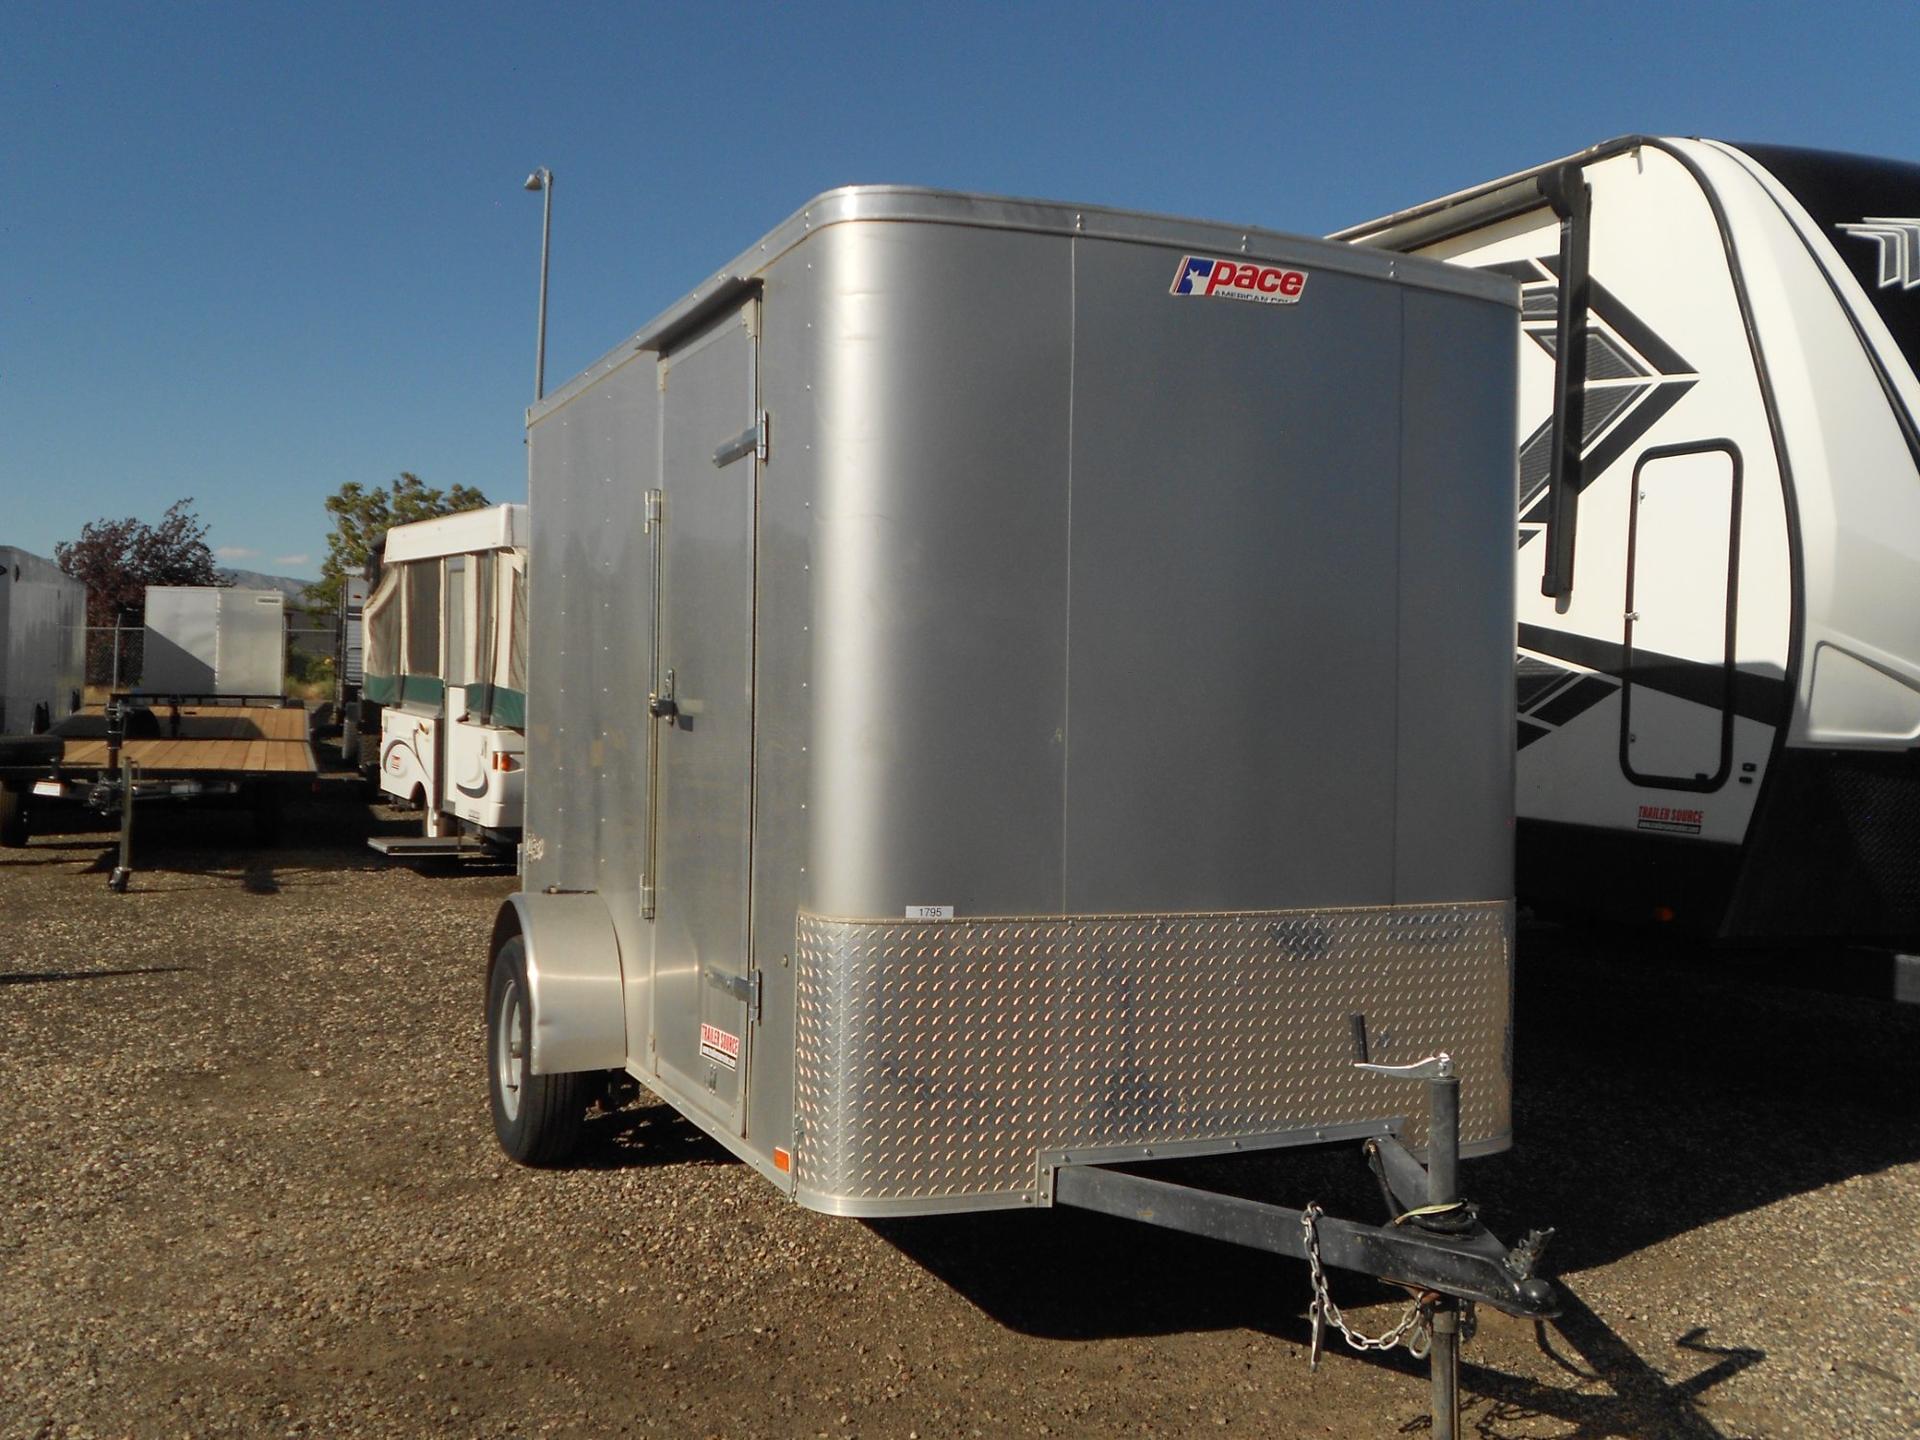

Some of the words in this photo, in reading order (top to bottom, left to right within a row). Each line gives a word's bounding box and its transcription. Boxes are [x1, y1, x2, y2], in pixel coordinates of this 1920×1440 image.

[1205, 261, 1304, 296] pace
[1638, 806, 1669, 820] TRAILER
[1671, 809, 1704, 823] SOURCE
[919, 907, 942, 917] 1795
[702, 1025, 719, 1046] TRAILER
[720, 1032, 738, 1055] SOURCE
